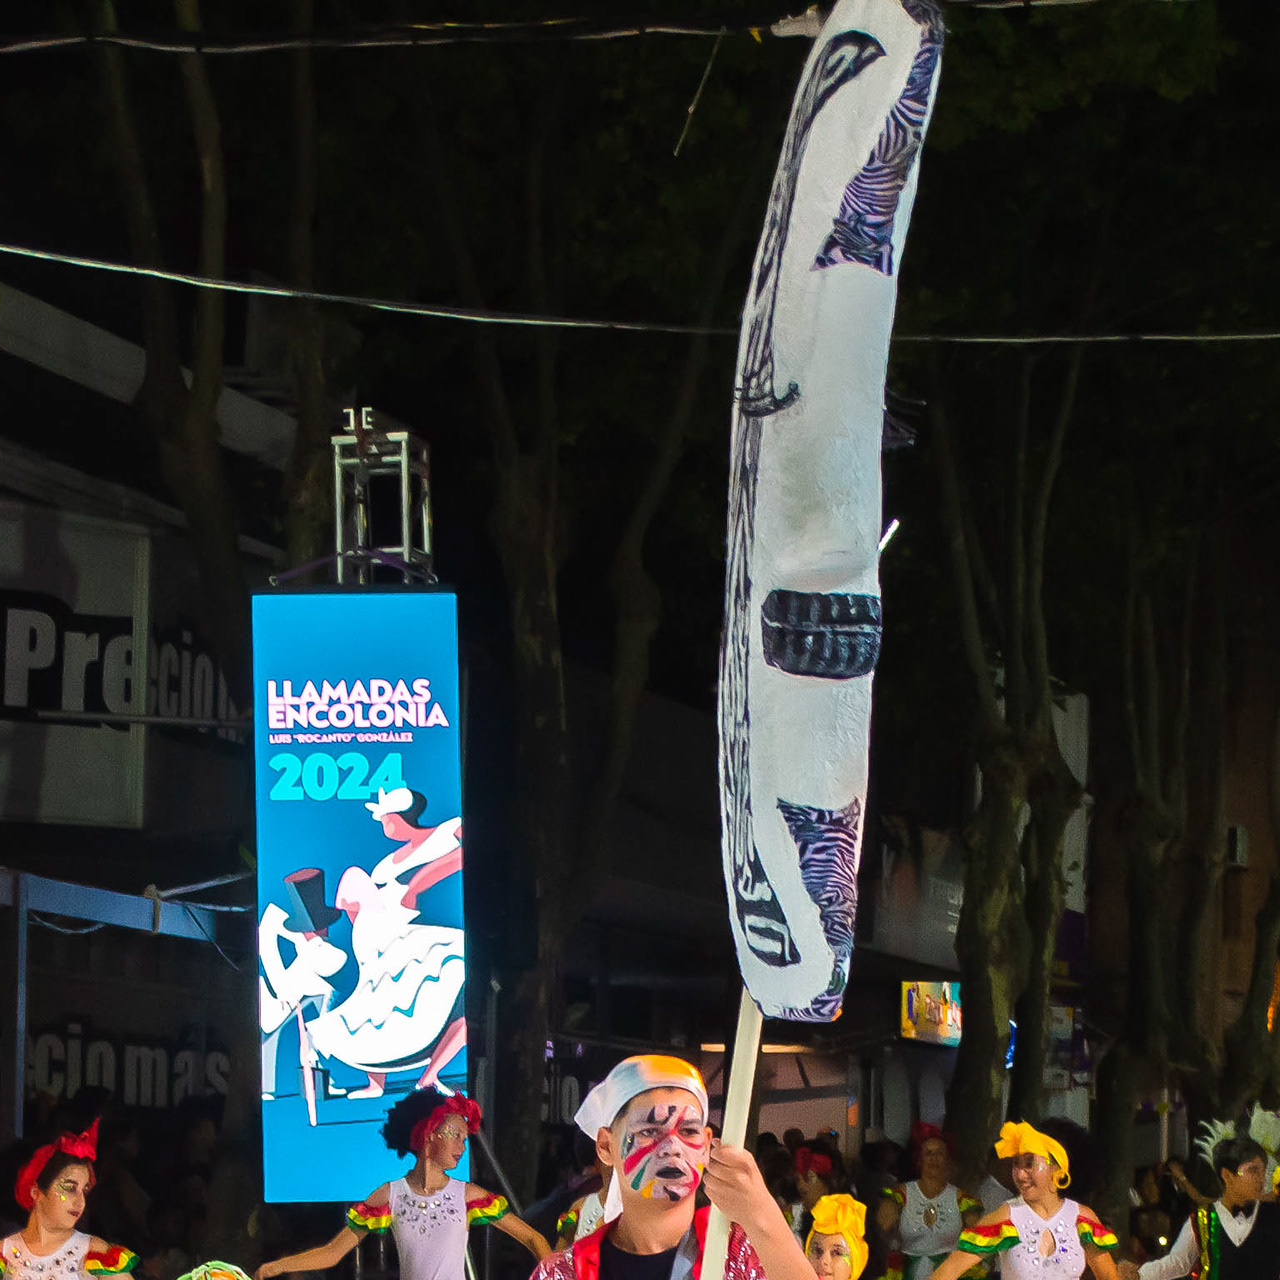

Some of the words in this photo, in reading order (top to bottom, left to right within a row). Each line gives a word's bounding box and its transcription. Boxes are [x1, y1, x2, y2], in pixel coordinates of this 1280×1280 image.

[267, 678, 432, 704] LLAMADAS
[269, 733, 292, 744] LUIS
[269, 752, 407, 801] 2024
